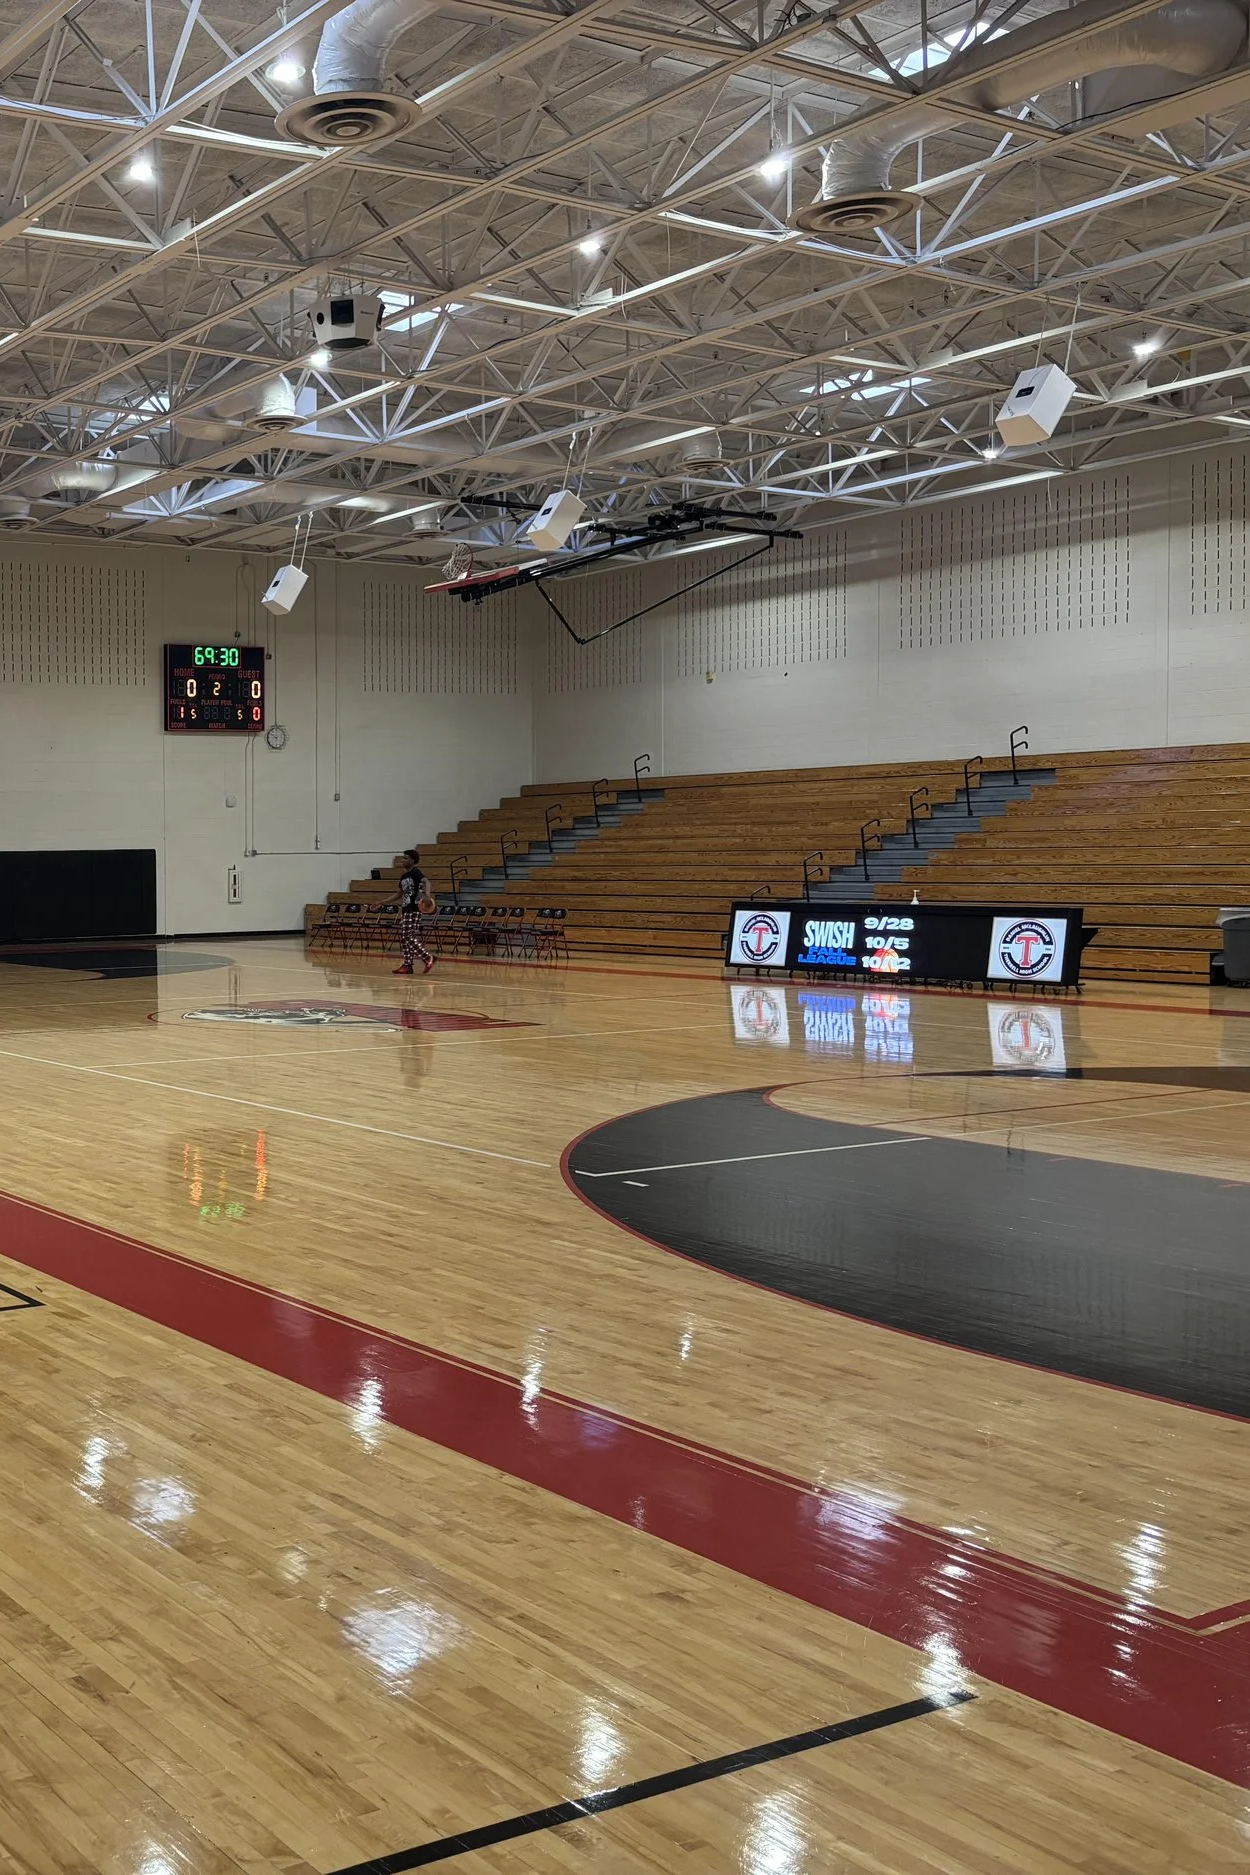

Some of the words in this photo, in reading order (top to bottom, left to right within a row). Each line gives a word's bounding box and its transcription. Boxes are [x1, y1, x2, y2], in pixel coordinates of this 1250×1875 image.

[195, 647, 239, 666] 69:30
[174, 668, 195, 677] HOME
[237, 670, 260, 678] GUEST
[187, 679, 197, 697] 0
[213, 681, 221, 696] 2
[251, 680, 261, 699] 0
[253, 706, 261, 721] 0
[864, 917, 915, 931] 9/28
[752, 926, 770, 955] T
[803, 920, 856, 948] SWISH
[865, 937, 910, 950] 10/5
[808, 946, 847, 957] FALL
[1015, 935, 1041, 968] T
[798, 954, 857, 966] LEAGUE
[1003, 953, 1019, 974] THERRELL
[1032, 956, 1049, 972] SCHOOL
